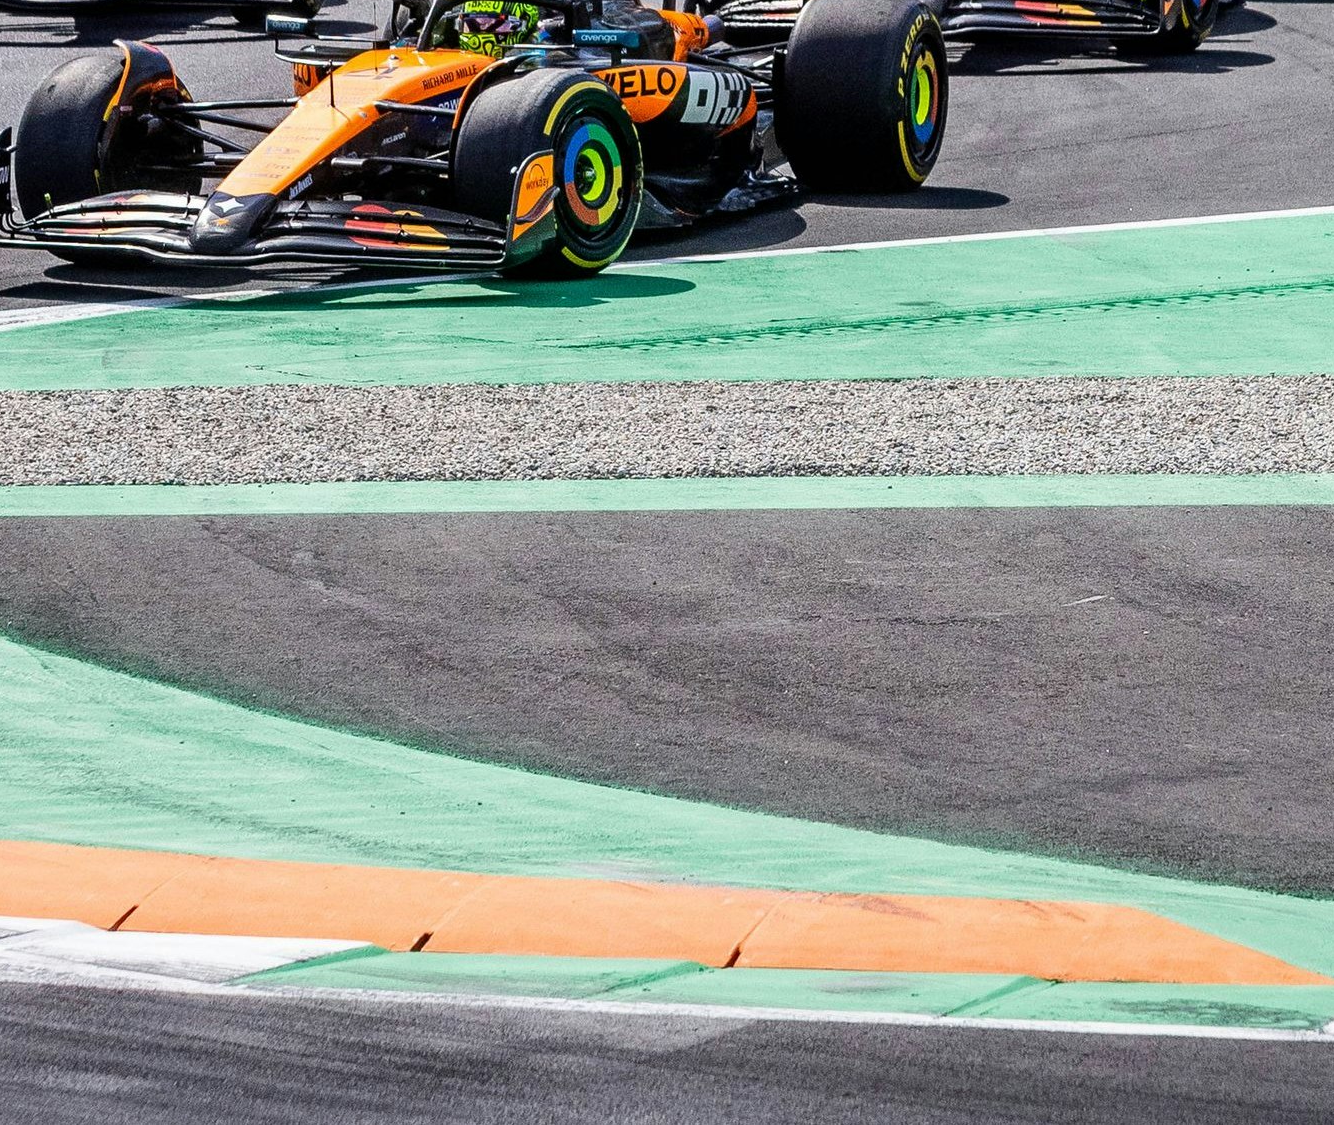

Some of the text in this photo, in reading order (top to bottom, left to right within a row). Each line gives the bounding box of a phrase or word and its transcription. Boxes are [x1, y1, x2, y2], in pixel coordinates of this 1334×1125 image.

[580, 33, 618, 44] avenga
[421, 63, 479, 91] RICHARD MILLE
